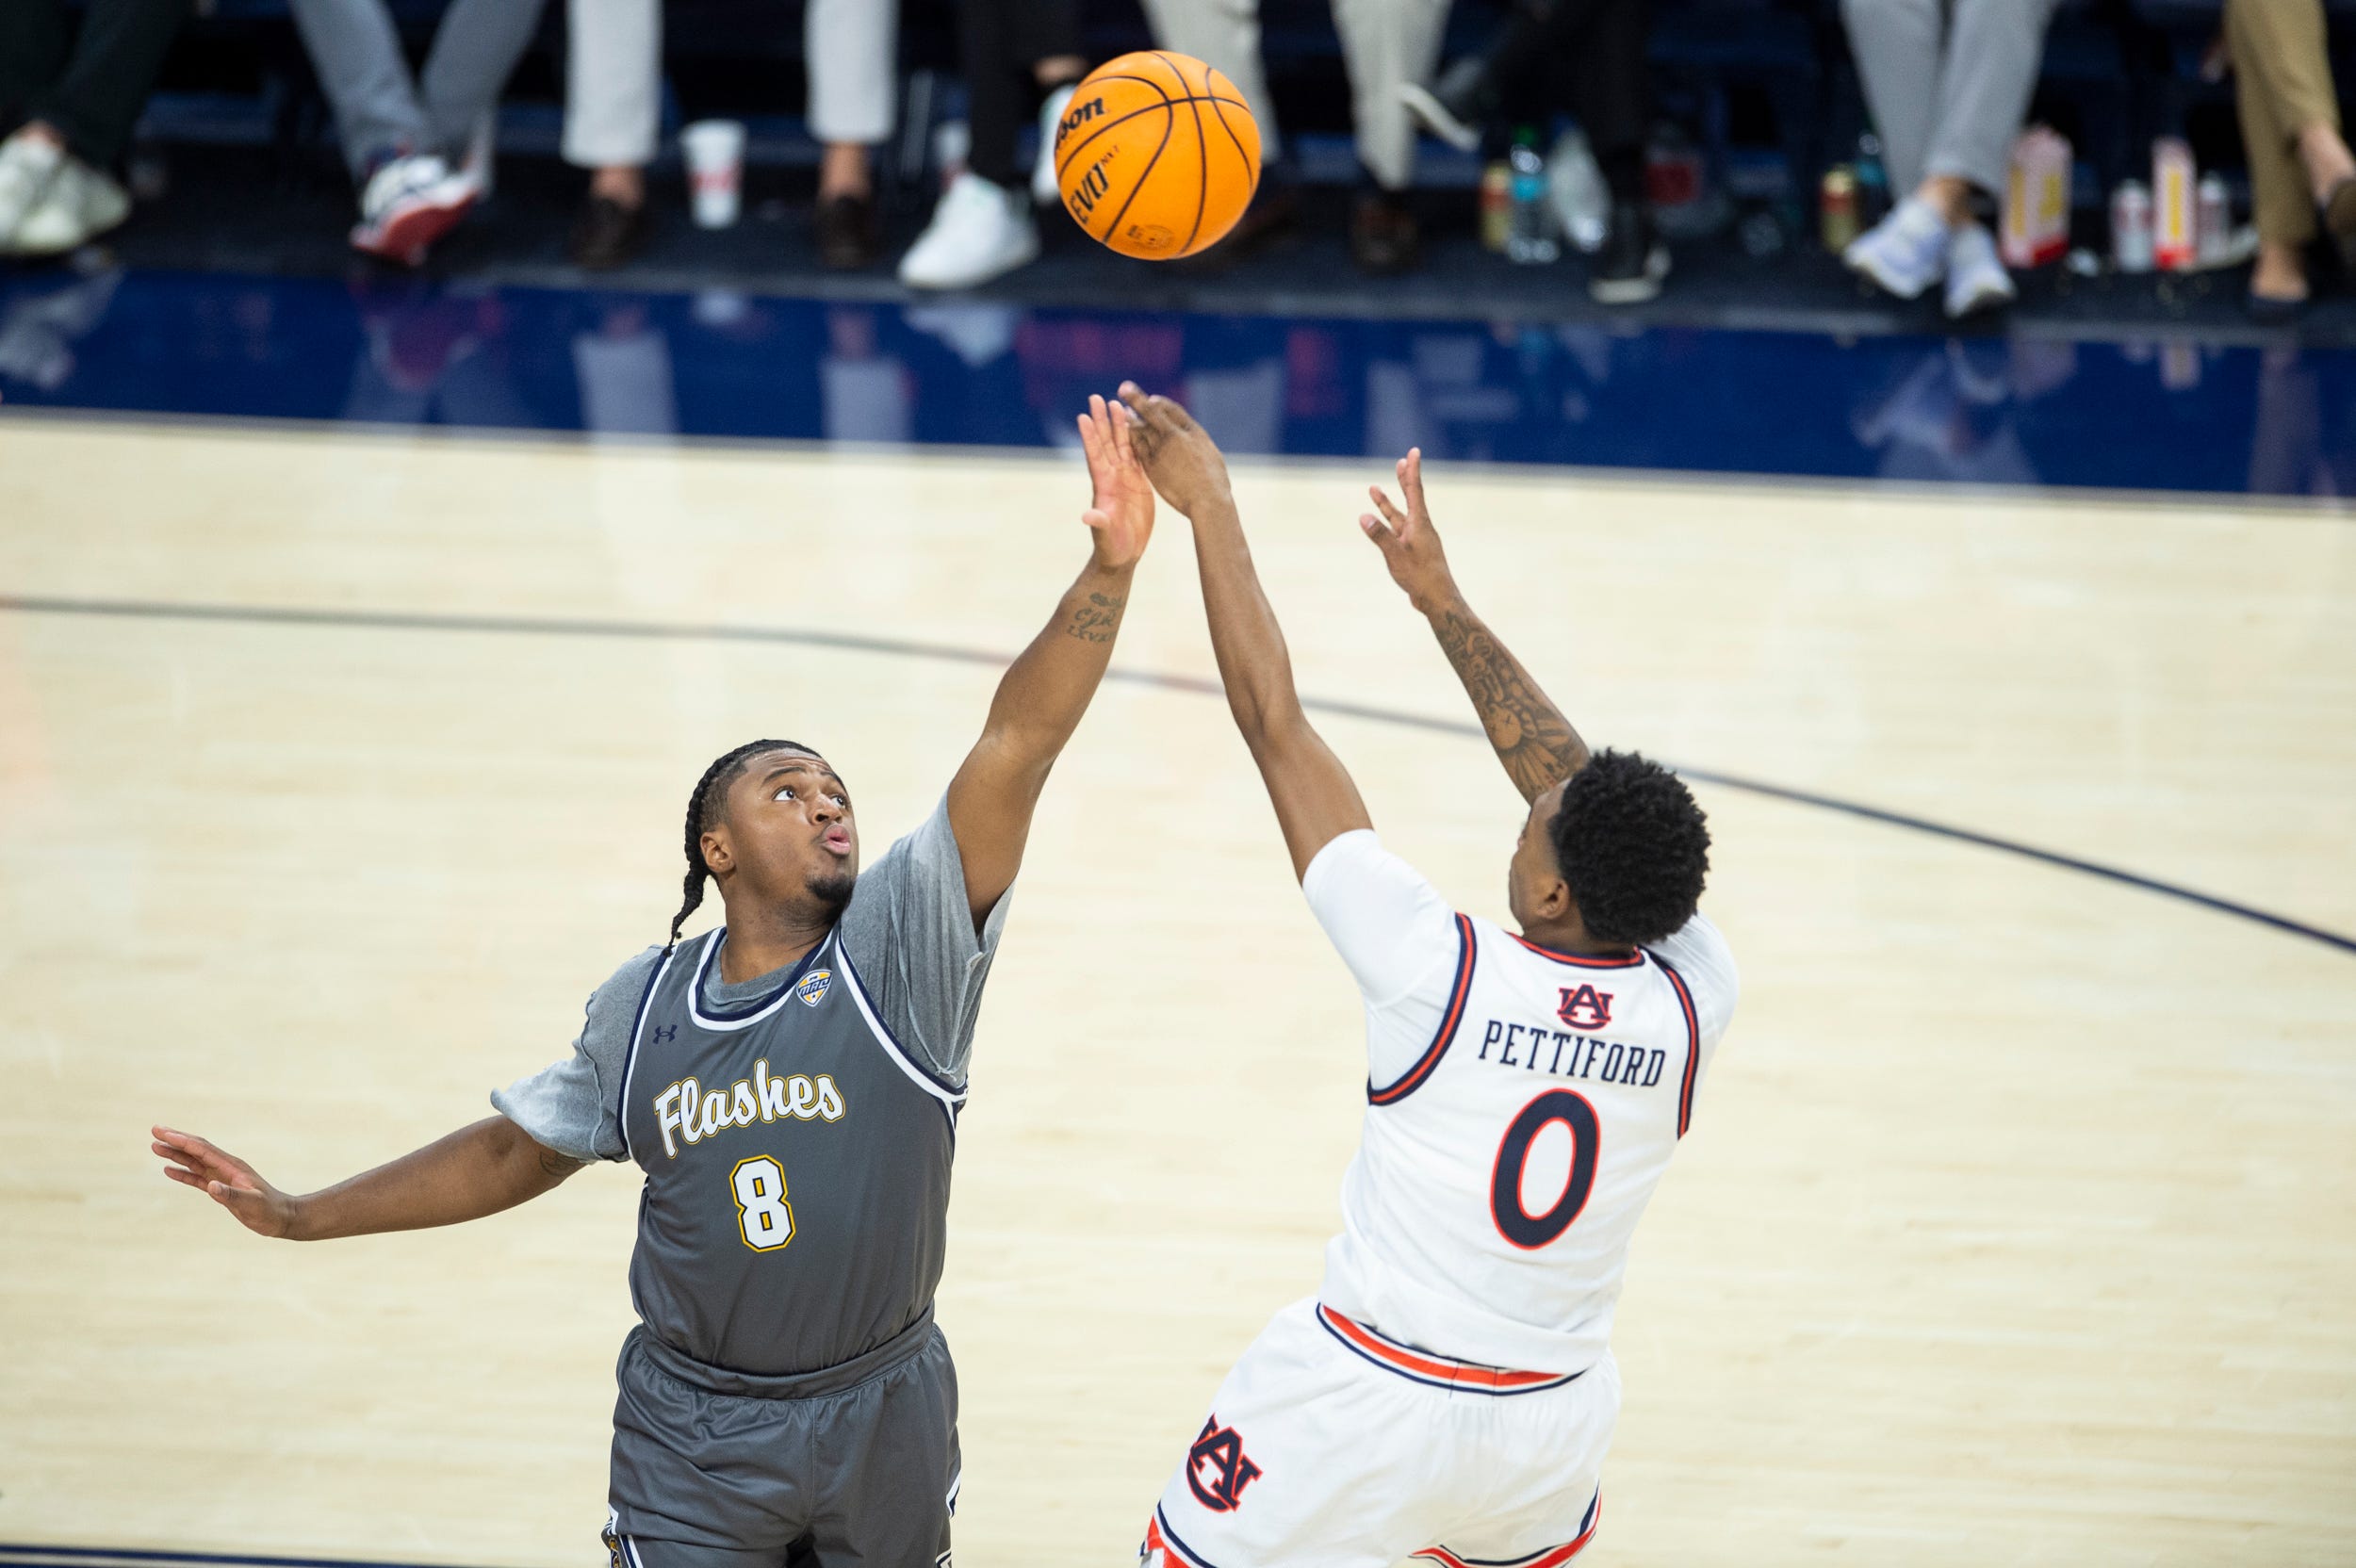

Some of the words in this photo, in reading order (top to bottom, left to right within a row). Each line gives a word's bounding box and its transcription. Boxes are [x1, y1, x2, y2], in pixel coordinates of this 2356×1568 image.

[799, 978, 829, 995] MAC
[1479, 1020, 1665, 1086] PETTIFORD
[653, 1057, 845, 1159] Flashes
[729, 1153, 796, 1252] 8
[1490, 1087, 1600, 1250] 0
